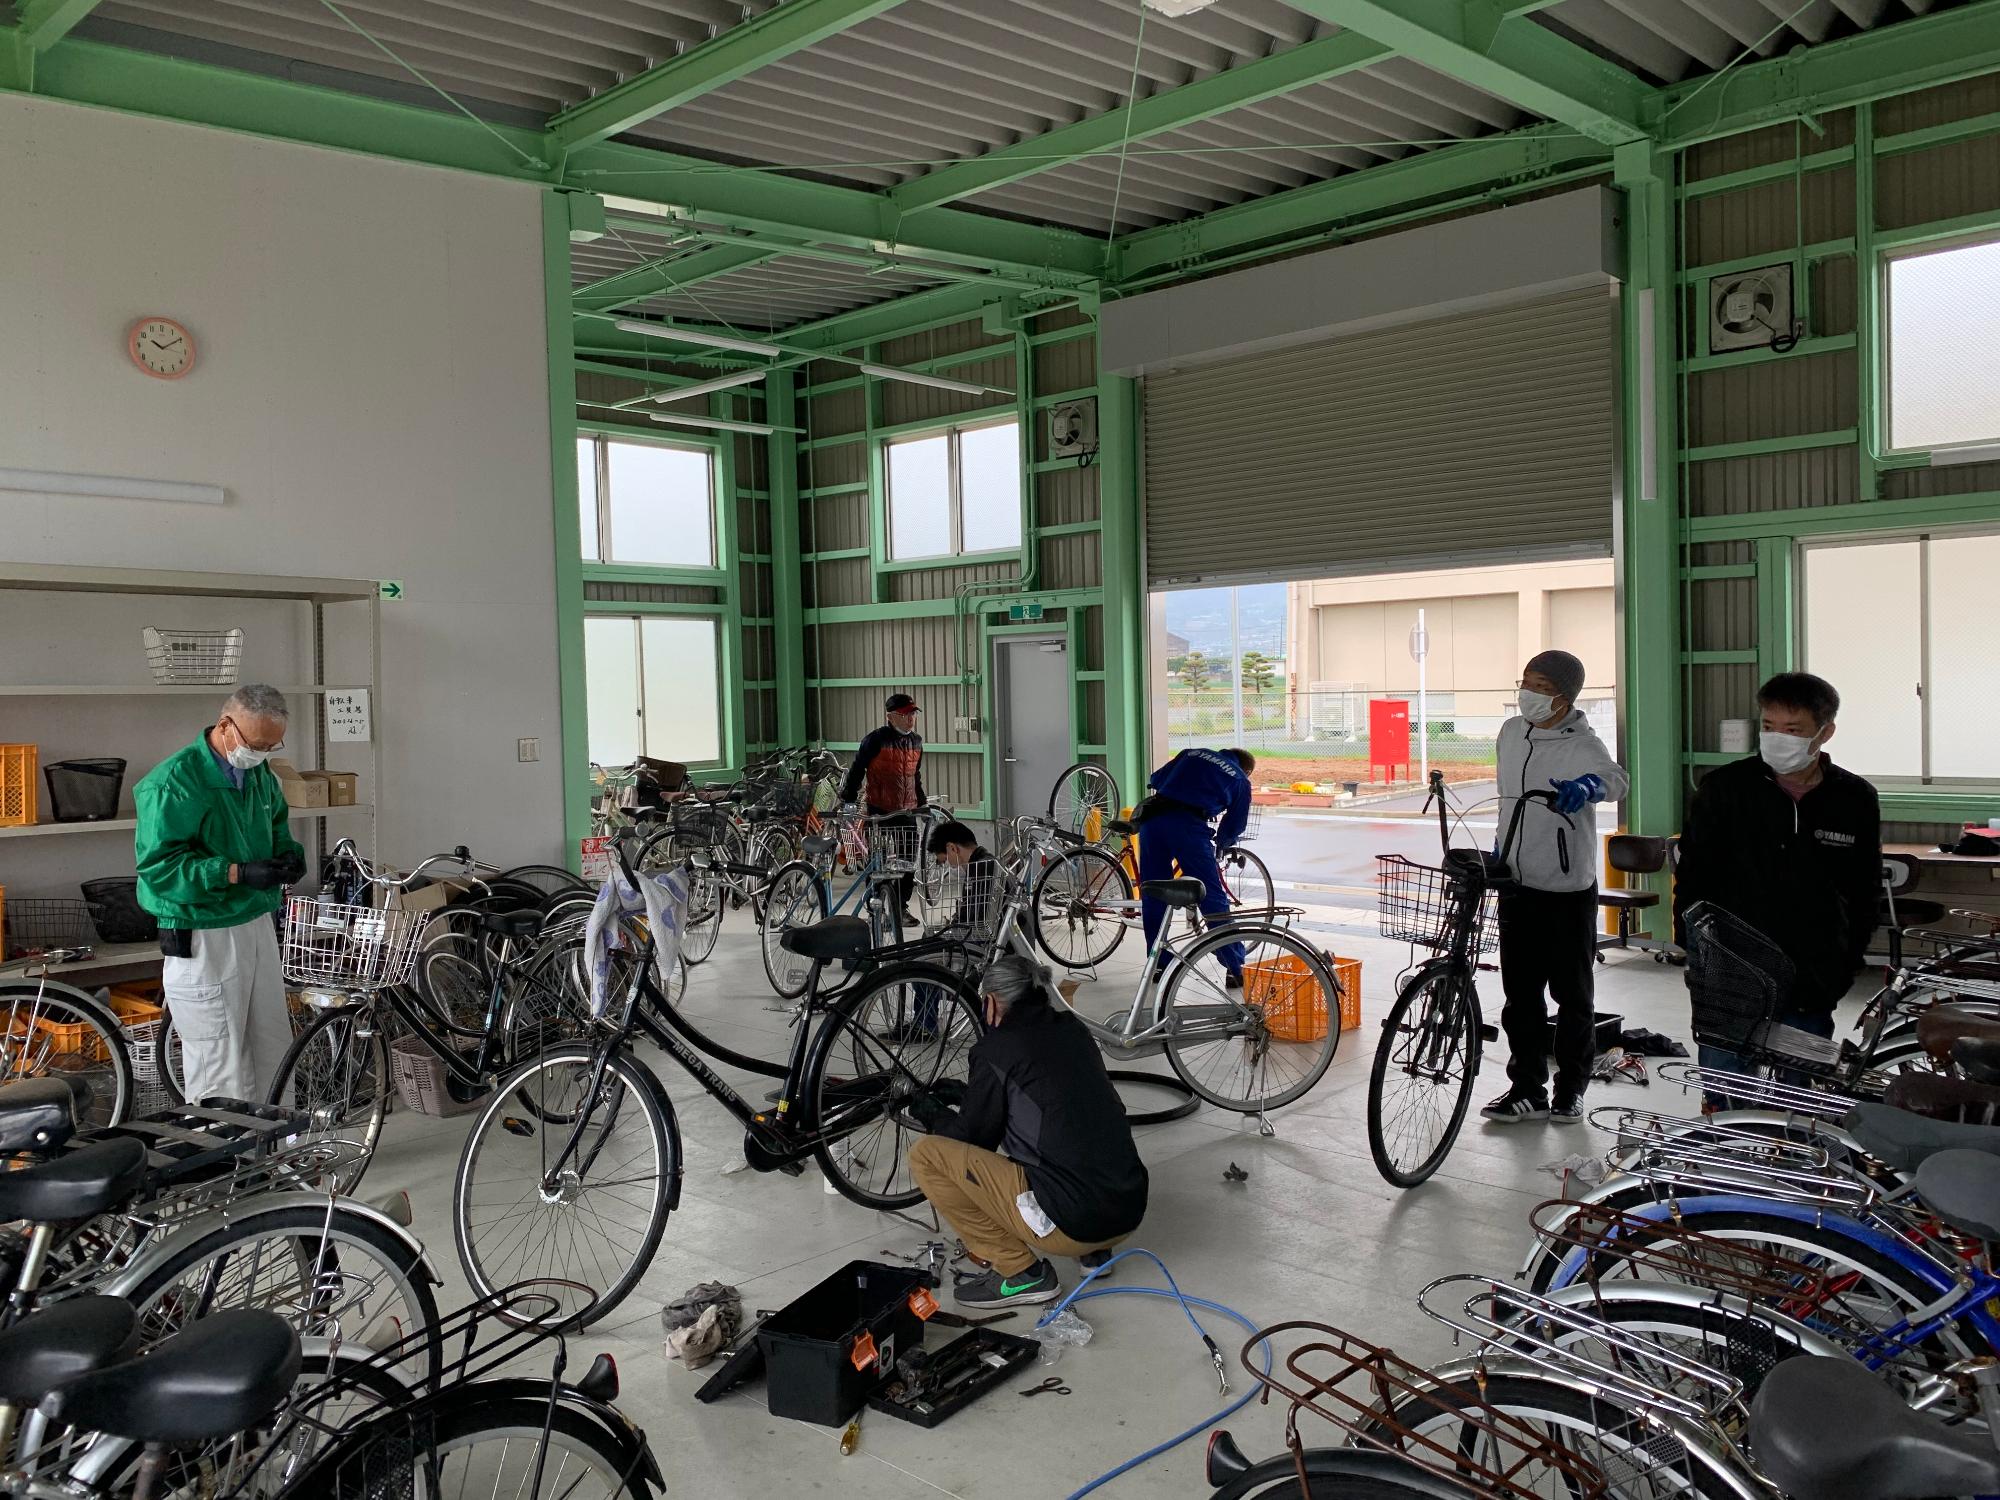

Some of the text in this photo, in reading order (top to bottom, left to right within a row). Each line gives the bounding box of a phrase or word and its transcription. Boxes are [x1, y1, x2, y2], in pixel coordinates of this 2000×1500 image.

[1199, 752, 1237, 777] YAMAHA
[1824, 831, 1856, 844] YAMAHA
[672, 1040, 738, 1102] MEGA TRANS
